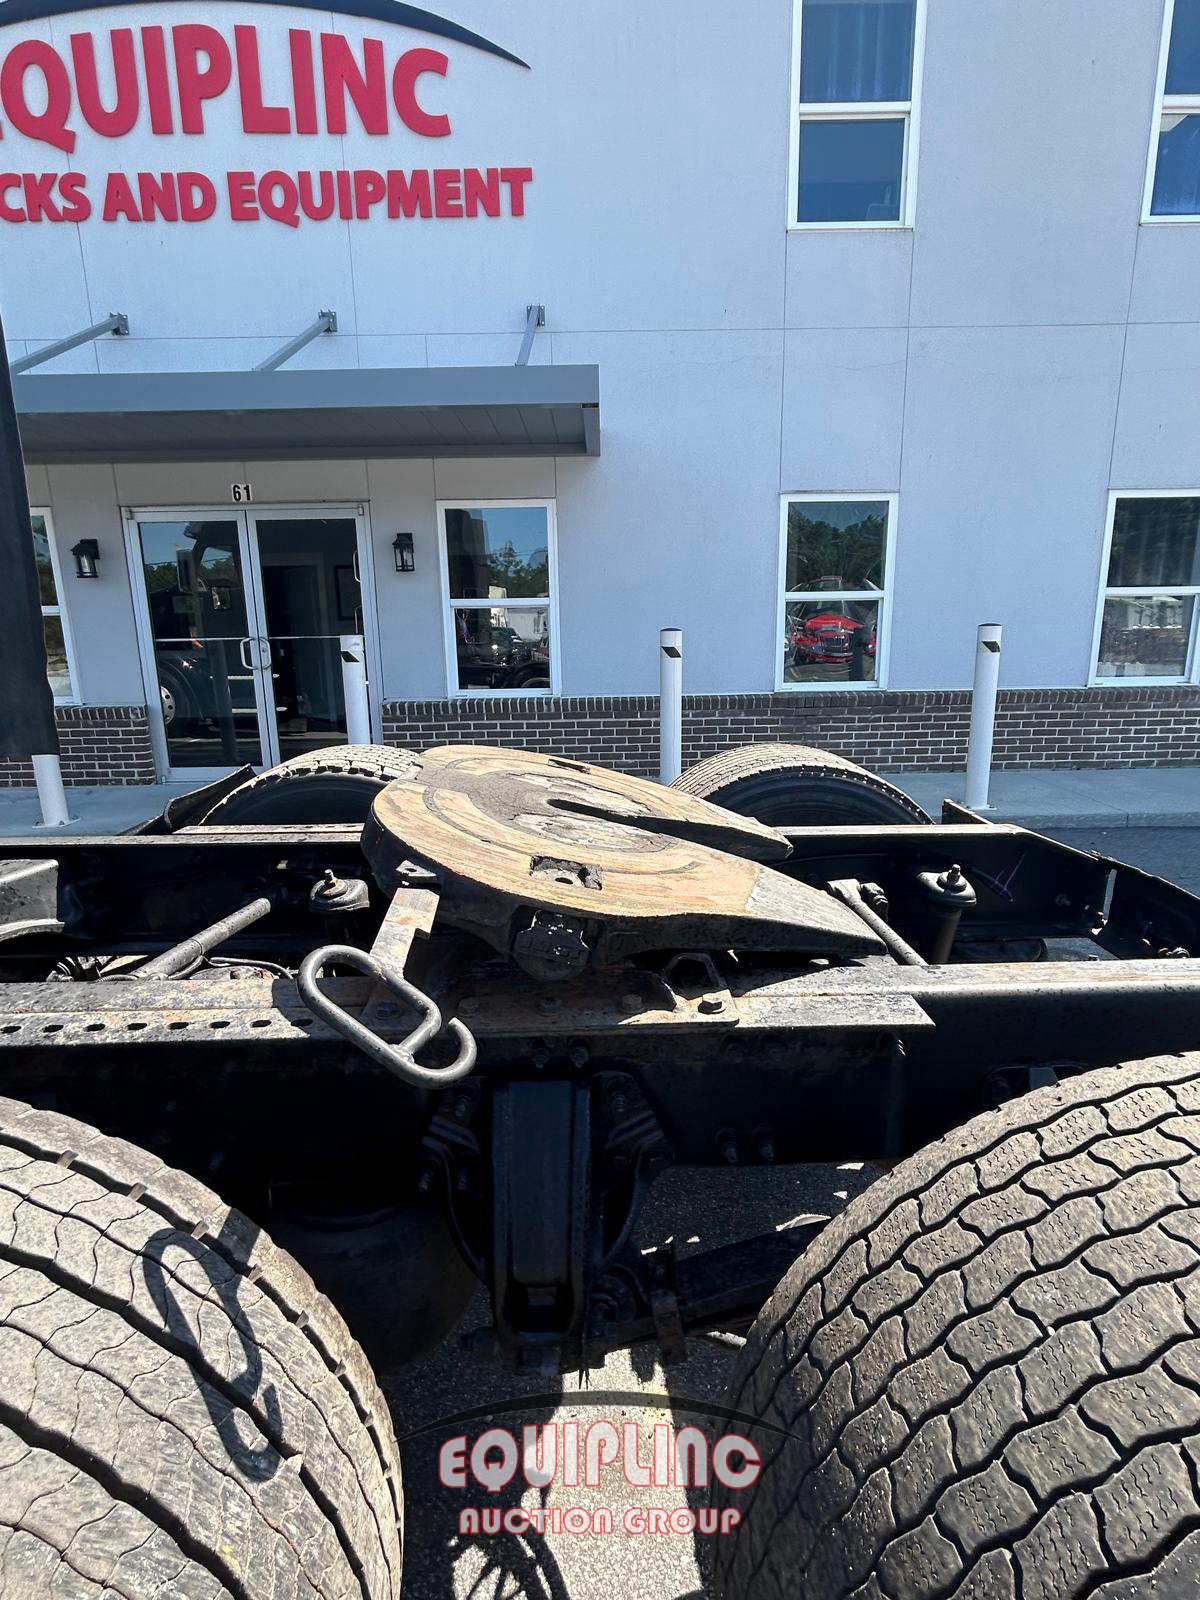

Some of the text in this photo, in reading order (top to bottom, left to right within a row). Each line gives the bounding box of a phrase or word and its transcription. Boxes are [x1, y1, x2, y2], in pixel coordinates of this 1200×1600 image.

[0, 24, 451, 153] QUIPLINC
[0, 167, 533, 228] CKS AND EQUIPMENT
[232, 484, 251, 502] 61
